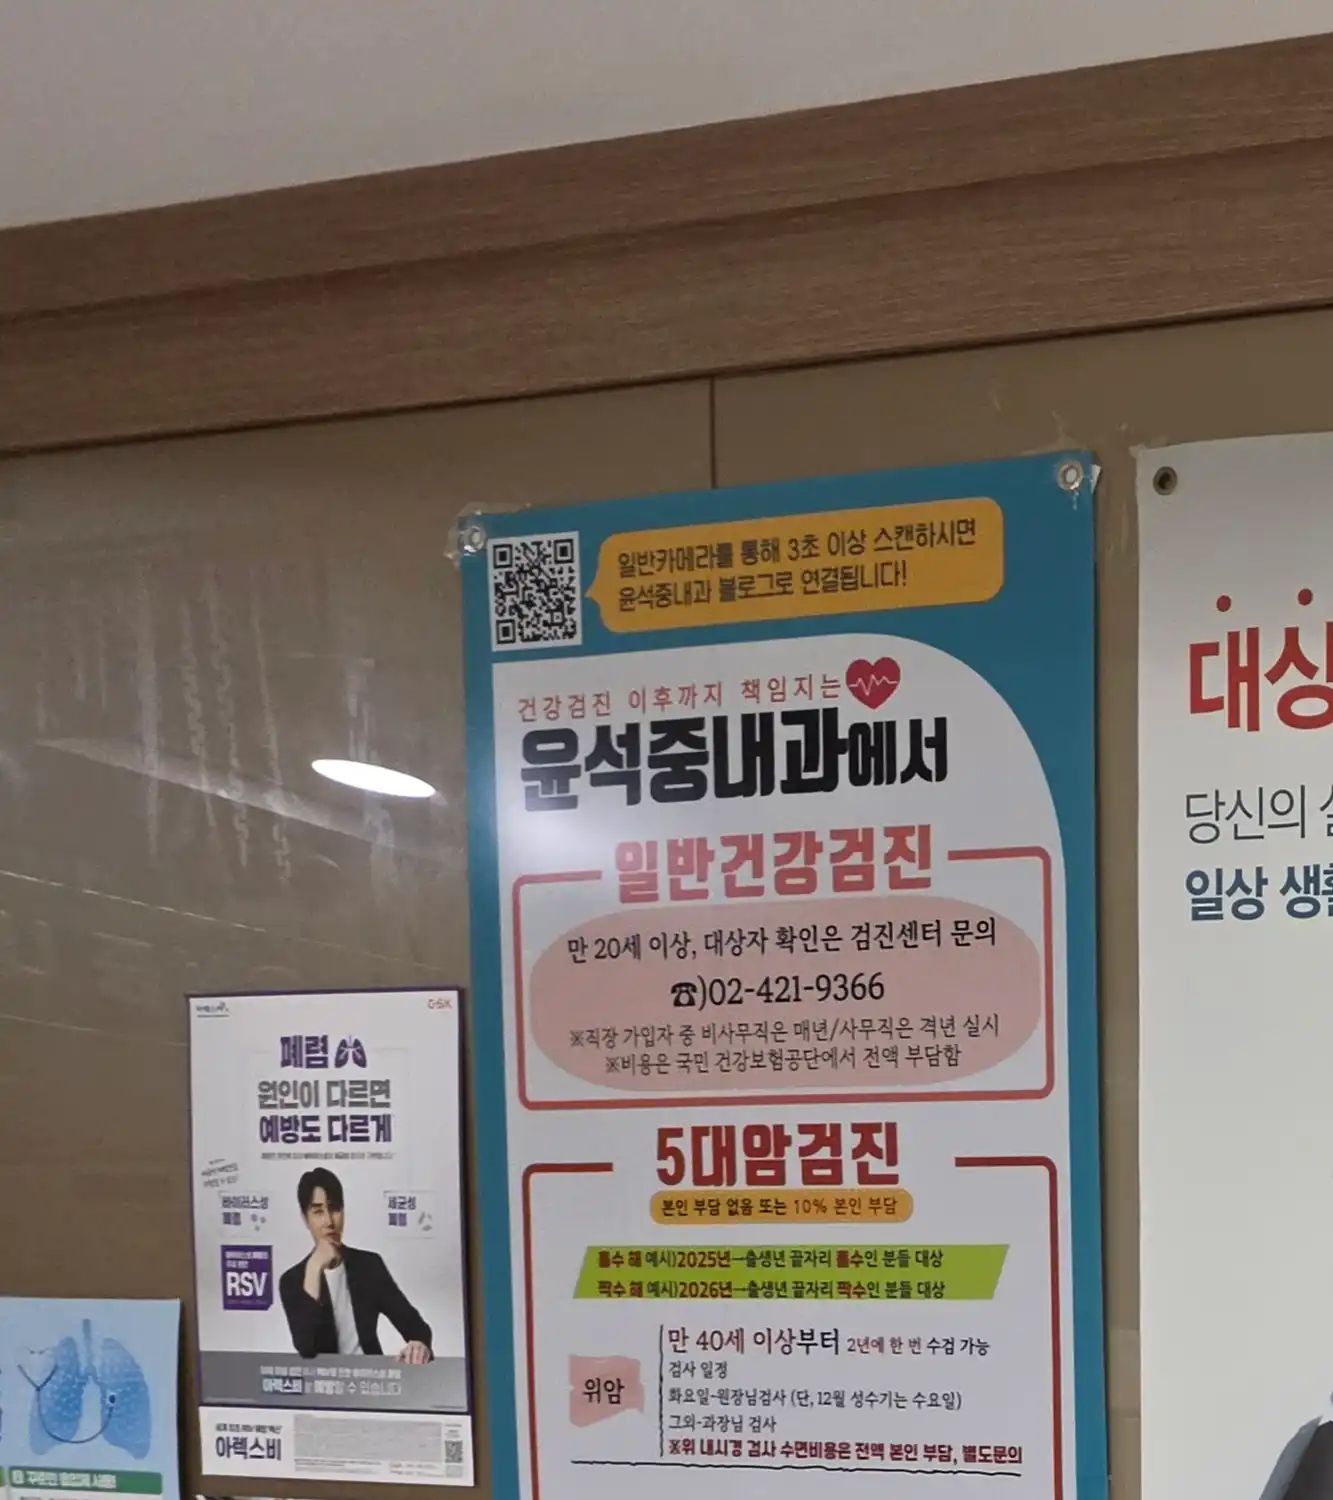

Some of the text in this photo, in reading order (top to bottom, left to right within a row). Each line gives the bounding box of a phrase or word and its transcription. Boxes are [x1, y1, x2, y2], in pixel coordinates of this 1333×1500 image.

[617, 519, 977, 579] 일반카메라를 통해 3초 이상 스캔하시면
[617, 565, 908, 612] 윤석중내과 블로그로 연결됩니다!
[517, 674, 842, 722] 건강검진 이후까지 책임지는
[520, 707, 948, 811] 윤석중내과에서
[1186, 787, 1306, 844] 당신의
[615, 824, 933, 903] 일반건강검진
[1186, 866, 1268, 922] 일상
[568, 916, 996, 962] 만 20세 이상, 대상자 확인은 검진센터 문의
[280, 1035, 329, 1069] 폐렴
[623, 1026, 674, 1046] 가입자
[678, 1024, 697, 1044] 중
[702, 1020, 789, 1043] 비사무직은
[794, 1016, 913, 1042] 매년/사무직은
[919, 1016, 956, 1037] 격년
[963, 1014, 999, 1037] 실시
[258, 1079, 390, 1109] 원인이 다르면
[260, 1114, 392, 1144] 예방도 다르게
[656, 1122, 899, 1187] 5대암검진
[226, 1273, 267, 1296] RSV
[667, 1328, 989, 1356] 만 40세 이상부터 2년에 한 번 수검 가능
[582, 1378, 625, 1404] 위암
[216, 1436, 282, 1461] 아렉스비
